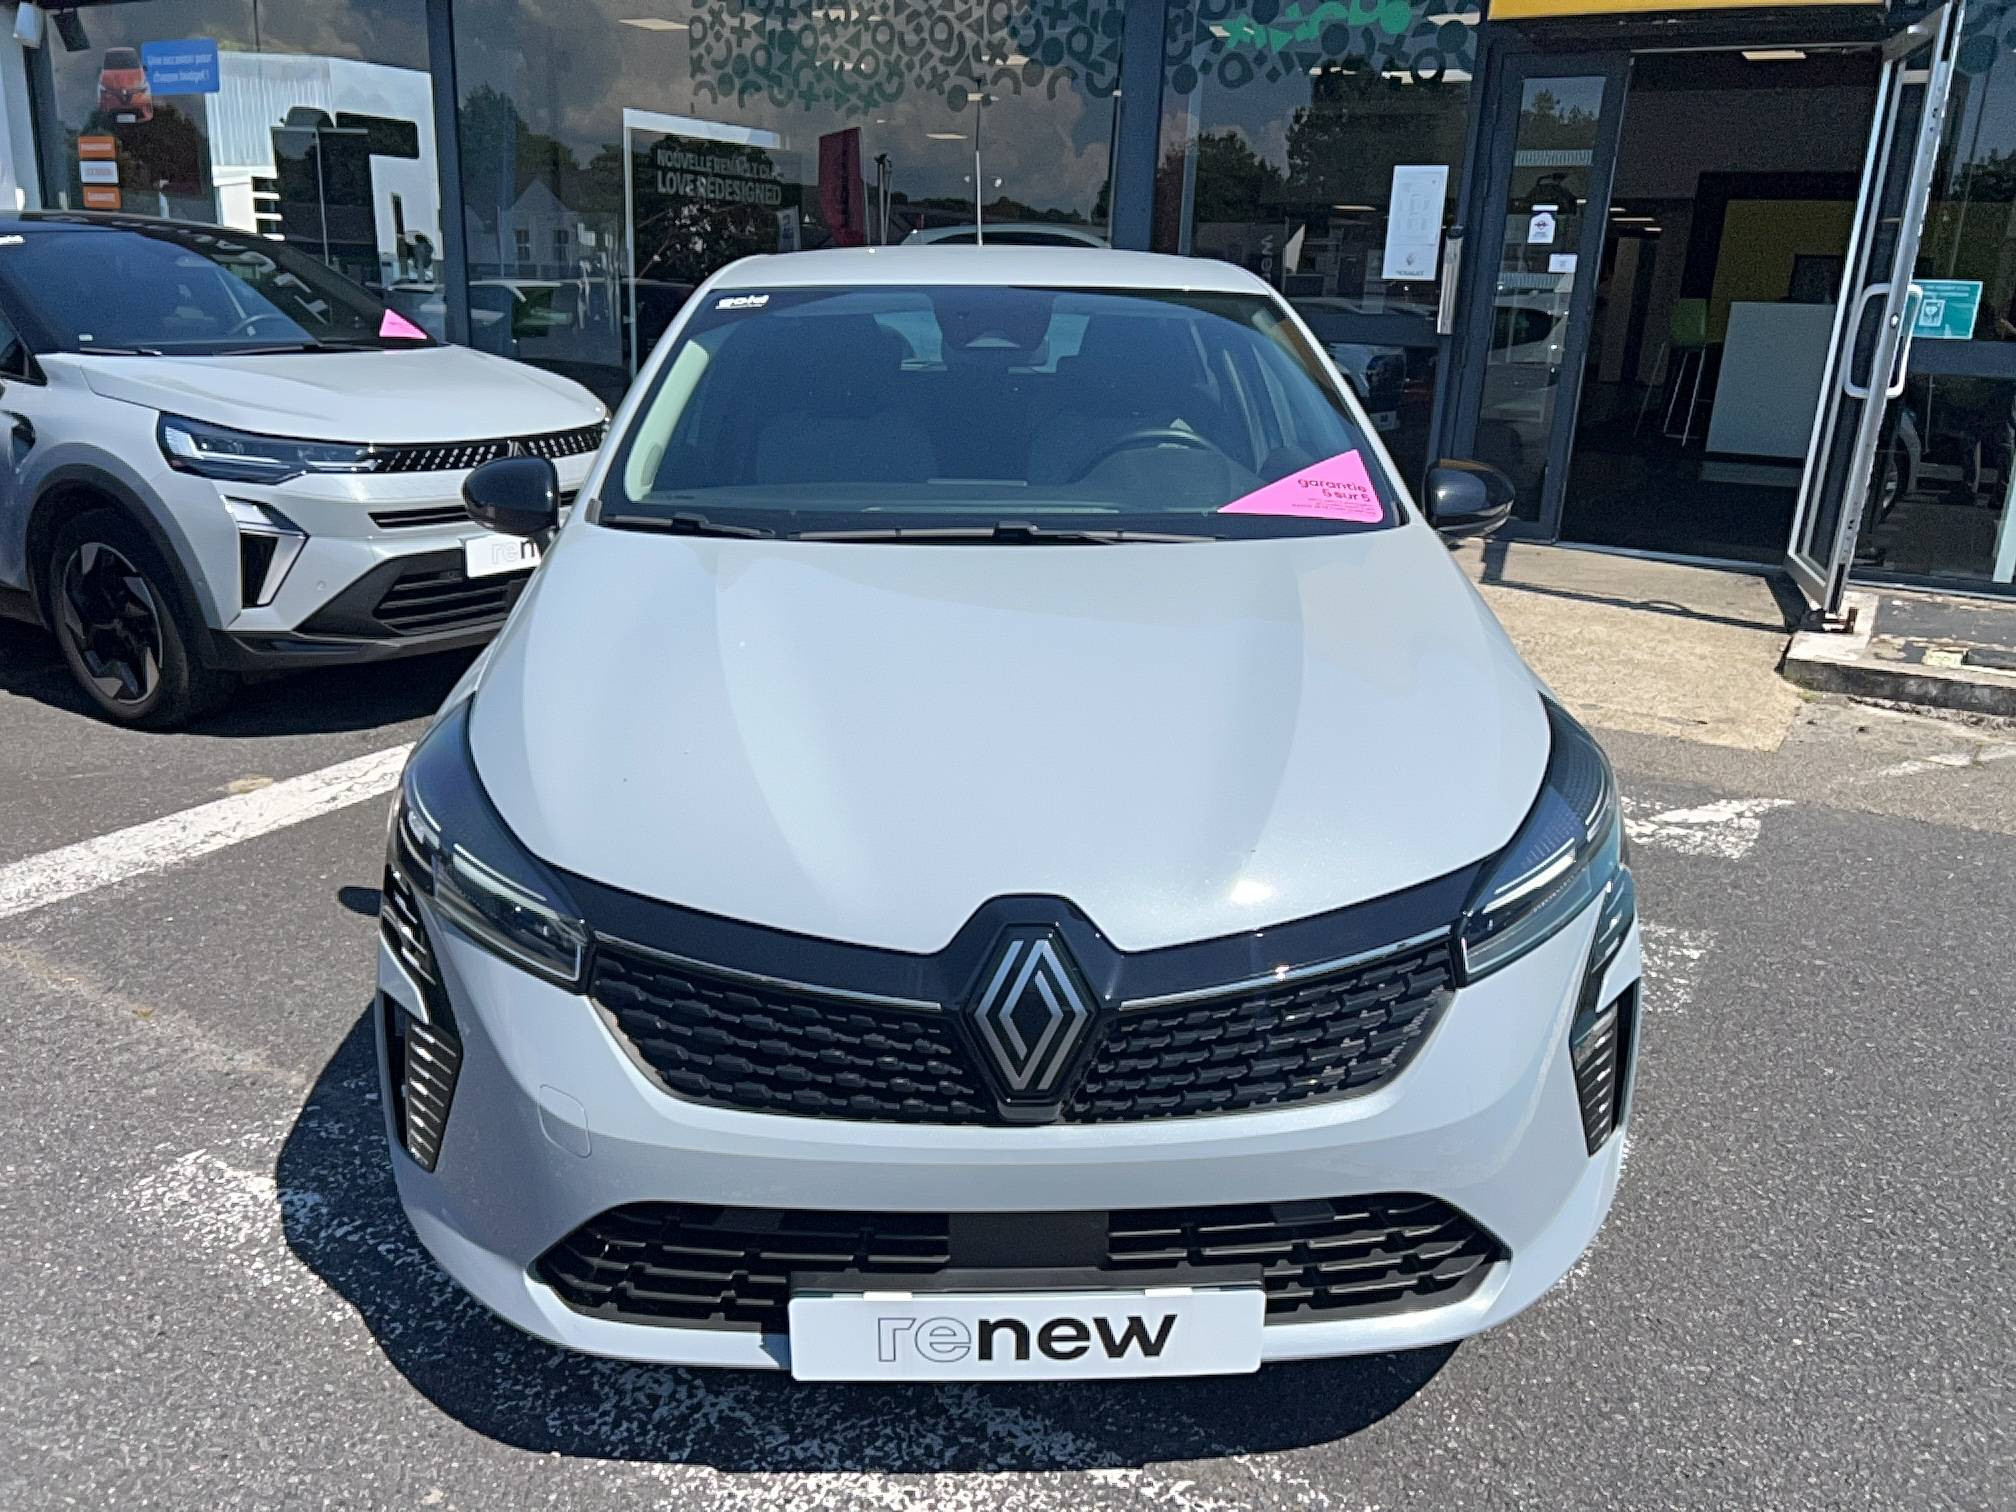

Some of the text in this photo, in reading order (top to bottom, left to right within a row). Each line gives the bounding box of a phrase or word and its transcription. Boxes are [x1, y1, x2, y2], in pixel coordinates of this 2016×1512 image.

[657, 170, 781, 205] LOVE REDESIGNED
[1297, 479, 1367, 492] garantie
[1335, 492, 1358, 500] sur
[878, 1313, 1178, 1363] renew
